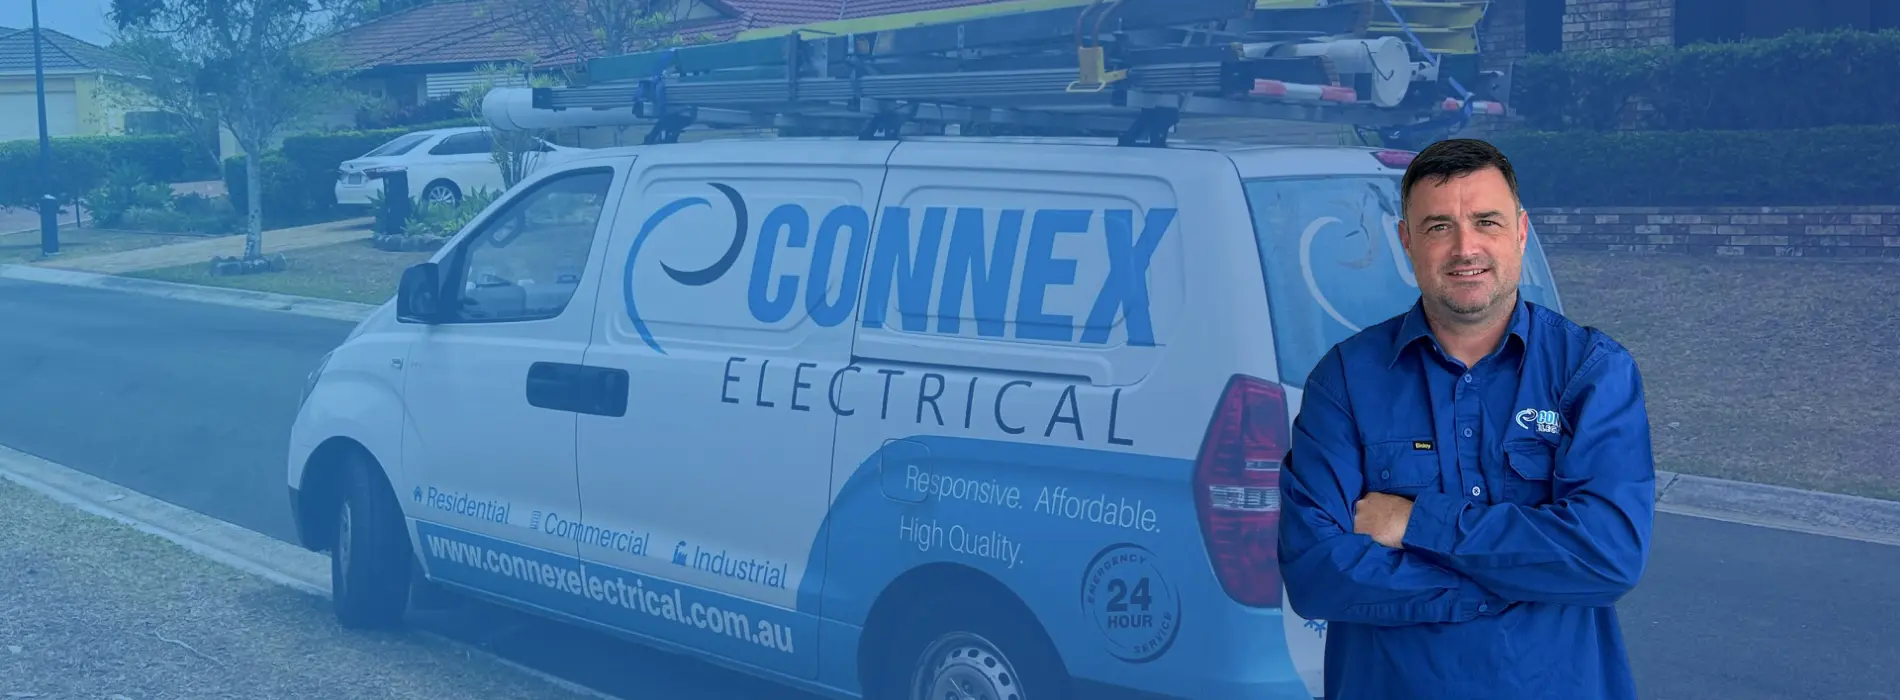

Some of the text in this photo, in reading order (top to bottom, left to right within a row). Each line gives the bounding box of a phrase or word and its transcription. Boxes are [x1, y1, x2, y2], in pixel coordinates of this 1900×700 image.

[747, 203, 1178, 347] CONNEX
[720, 356, 1134, 447] ELECTRICAL
[906, 464, 1161, 533] Responsive. Affordable.
[426, 486, 788, 590] Residential Commercial Industrial
[899, 515, 1024, 569] High Quality.
[427, 533, 794, 654] www.connexelectrical.com.au
[1087, 553, 1146, 604] EMERGENCY
[1106, 576, 1153, 613] 24
[1107, 614, 1153, 629] HOUR
[1133, 611, 1172, 654] SERVICE
